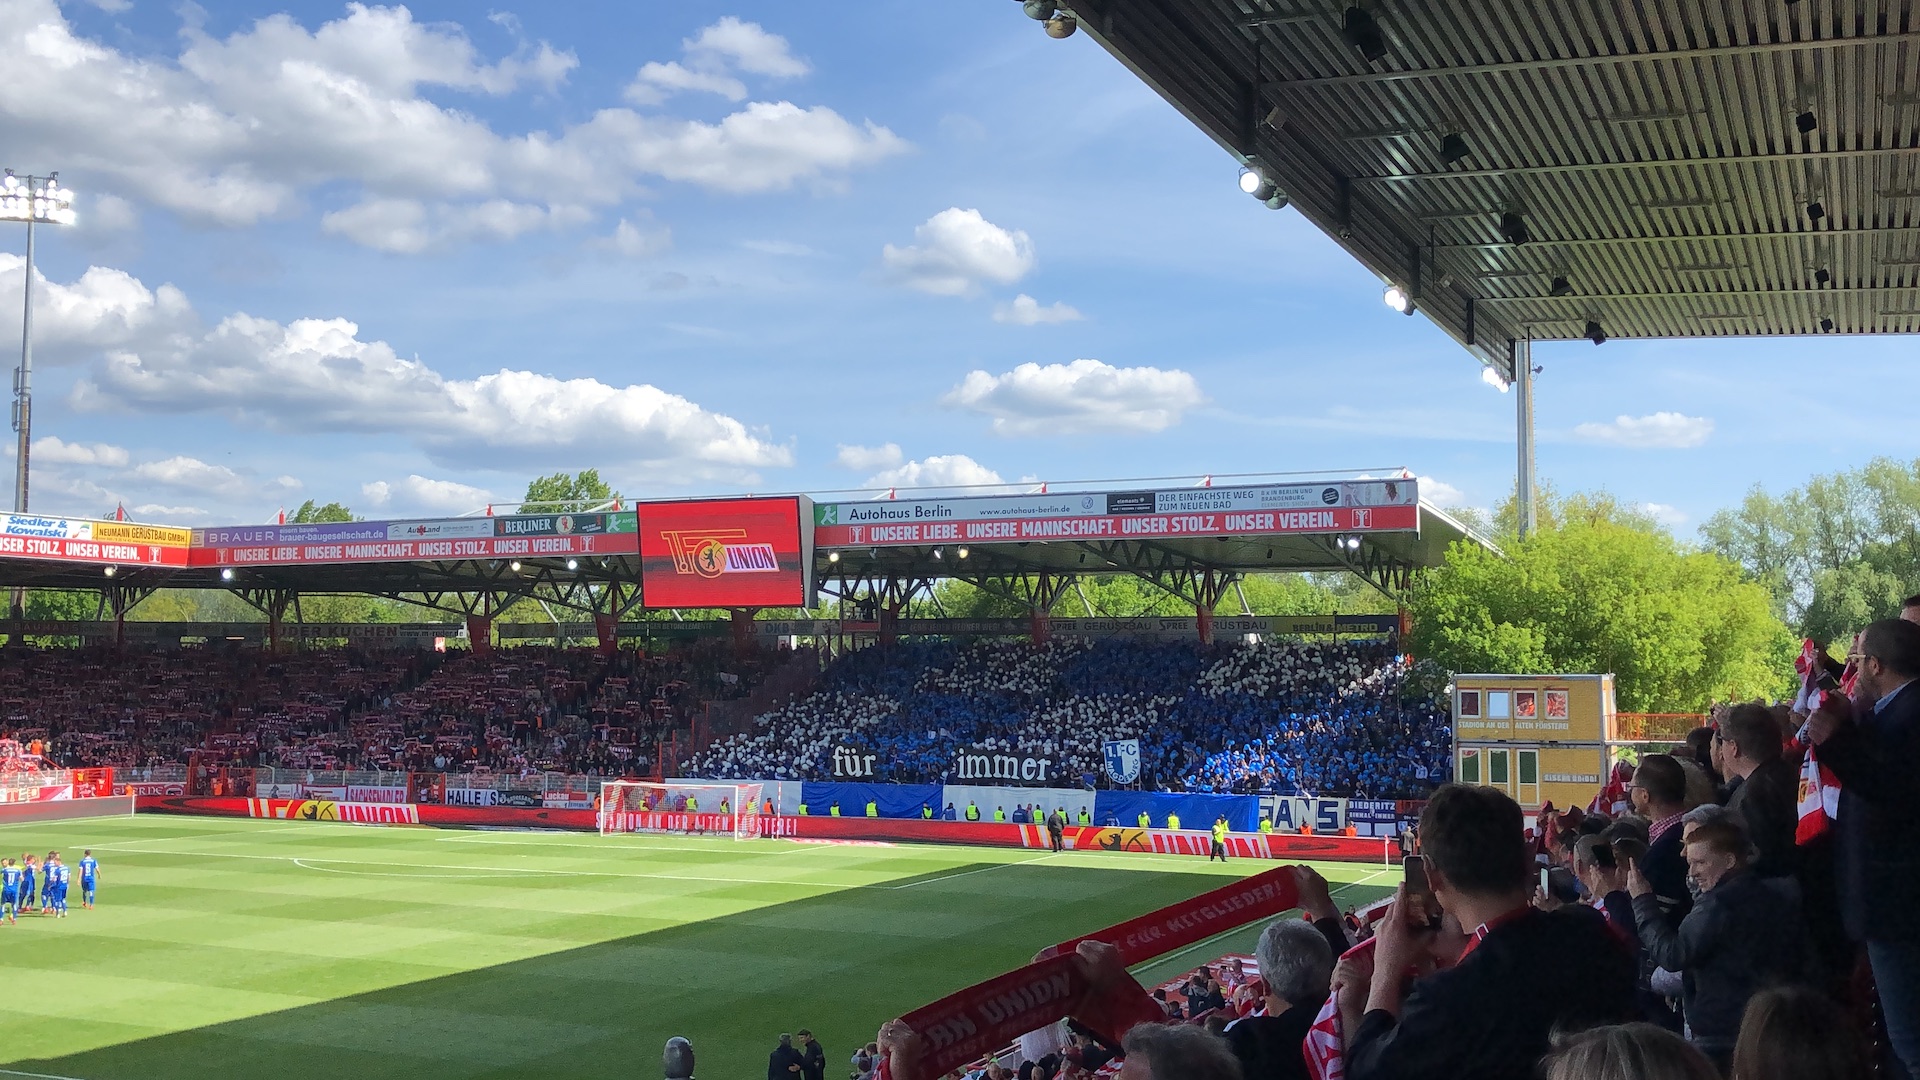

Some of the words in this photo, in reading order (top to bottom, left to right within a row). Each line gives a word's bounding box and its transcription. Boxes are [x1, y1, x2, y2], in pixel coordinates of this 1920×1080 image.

[1158, 493, 1176, 502] DER
[1178, 491, 1231, 501] EINFACHSTE
[1233, 490, 1254, 499] WEG
[1261, 494, 1305, 502] BRANDENBURG
[979, 504, 1071, 516] www.autohaus-berlin.de
[1158, 502, 1178, 511] ZUM
[1180, 501, 1210, 510] NEUEN
[1213, 500, 1232, 509] BAD
[849, 507, 910, 521] Autohaus
[915, 504, 952, 518] Berlin
[8, 515, 56, 527] Siedler
[57, 519, 68, 529] &
[505, 517, 552, 534] BERLINER
[871, 525, 920, 542] UNSERE
[923, 523, 963, 540] LIEBE.
[966, 521, 1018, 539] UNSERE
[1021, 518, 1117, 537] MANNSCHAFT.
[1121, 516, 1168, 535] UNSER
[1171, 515, 1220, 532] STOLZ.
[1225, 513, 1275, 531] UNSER
[1278, 510, 1339, 528] VEREIN.
[6, 525, 68, 538] Kowalski
[99, 527, 130, 538] NEUMANN
[131, 526, 167, 541] GERÜSTBAU
[167, 532, 185, 542] GMBH
[209, 531, 275, 543] BRAUER
[279, 530, 384, 543] brauer-baugesellschaft.de
[0, 537, 25, 553] SER
[26, 539, 62, 556] STOLZ.
[65, 541, 100, 558] UNSER
[101, 544, 140, 561] VEREIN.
[233, 547, 270, 562] UNSERE
[272, 546, 302, 561] LIEBE.
[304, 545, 343, 560] UNSERE
[345, 543, 415, 558] MANNSCHAFT.
[418, 542, 453, 556] UNSER
[454, 541, 490, 555] STOLZ.
[493, 540, 528, 554] UNSER
[532, 538, 575, 553] VEREIN.
[725, 546, 776, 569] UNION
[14, 622, 79, 631] BAUHAUS
[765, 623, 790, 634] DKB
[1050, 620, 1077, 632] SPREE
[1084, 621, 1152, 631] GERÜSTBAU
[1158, 619, 1188, 631] SPREE
[564, 628, 593, 637] ELEMENT
[1458, 721, 1485, 729] STADION
[1486, 721, 1496, 729] AN
[1497, 721, 1510, 729] DER
[1515, 721, 1534, 729] ALTEN
[1535, 720, 1569, 730] FÖRSTEREI
[832, 745, 877, 777] für
[957, 747, 1052, 782] immer
[1107, 759, 1139, 782] MAGDEBURG
[447, 790, 481, 805] HALLE
[490, 790, 497, 805] S
[544, 791, 570, 801] Luckau
[1349, 800, 1396, 811] BIEDERITZ
[647, 813, 662, 829] AN
[667, 814, 688, 831] DER
[694, 815, 729, 832] ALTEN
[1166, 879, 1282, 933] MITGLIEDER!
[977, 971, 1070, 1026] UNION
